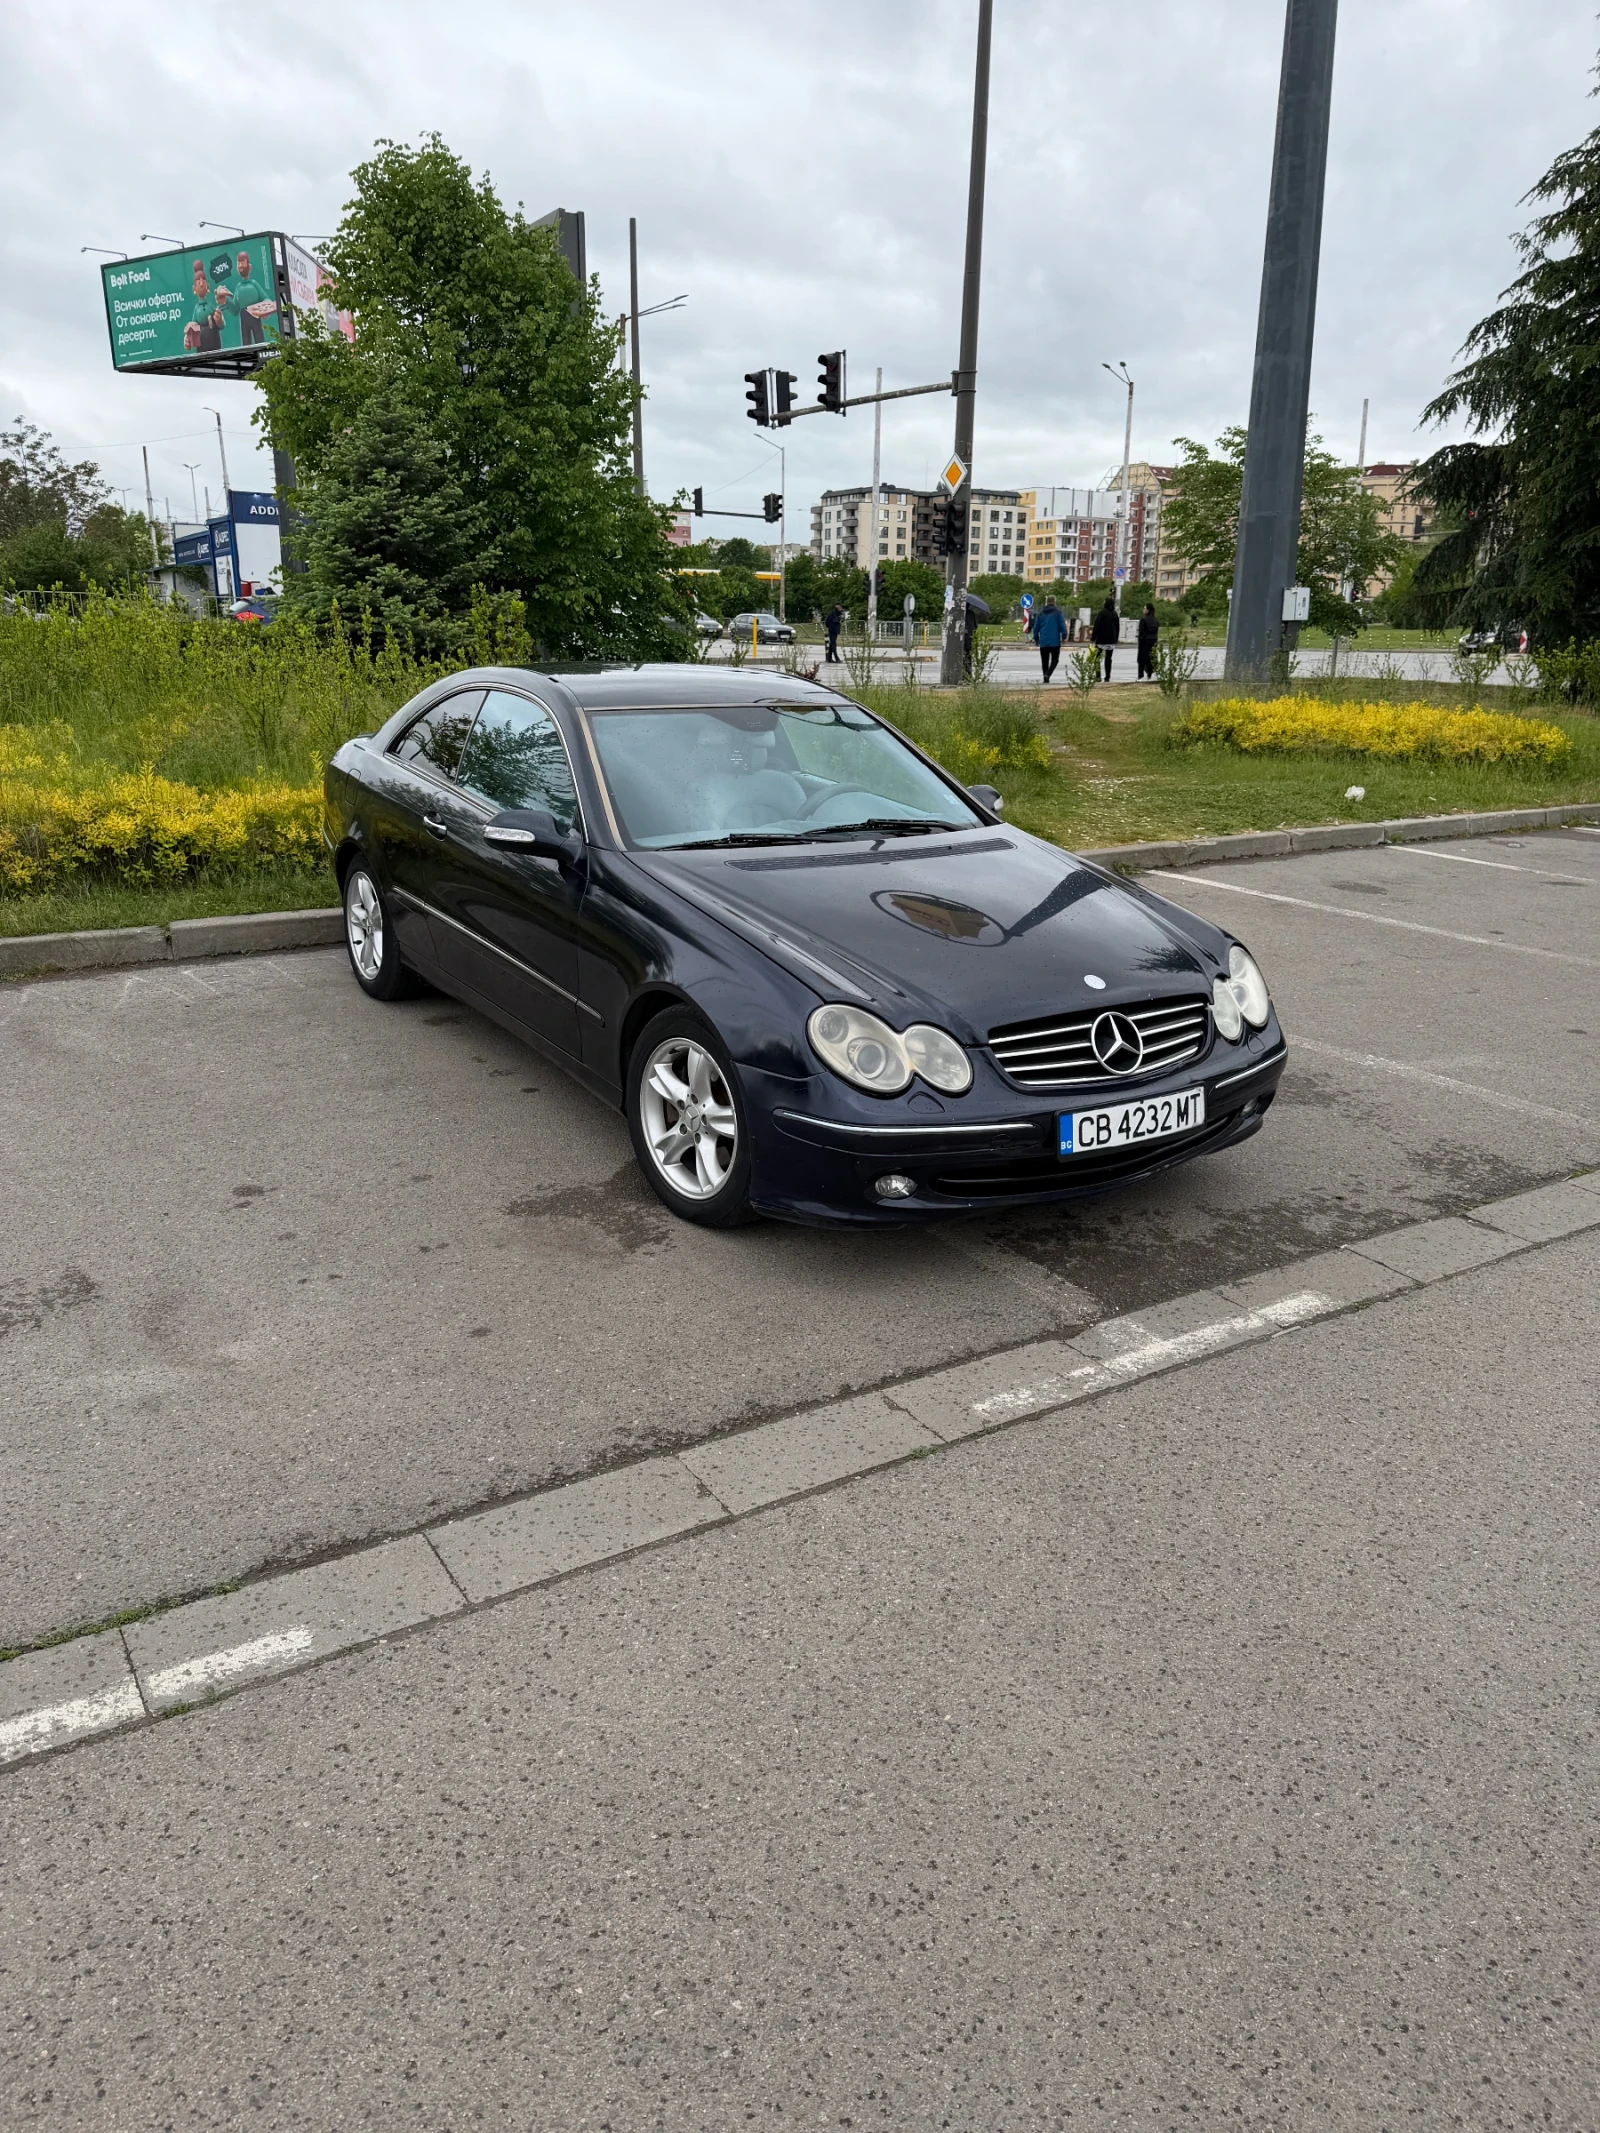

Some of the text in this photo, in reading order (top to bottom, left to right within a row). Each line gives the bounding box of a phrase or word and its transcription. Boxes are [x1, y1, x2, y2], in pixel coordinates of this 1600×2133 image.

[128, 267, 151, 284] Food
[114, 292, 185, 313] Всички оферти.
[116, 308, 182, 328] От основно до
[118, 329, 158, 346] десерти.
[1117, 1100, 1173, 1140] 4232
[1060, 1140, 1073, 1151] BG
